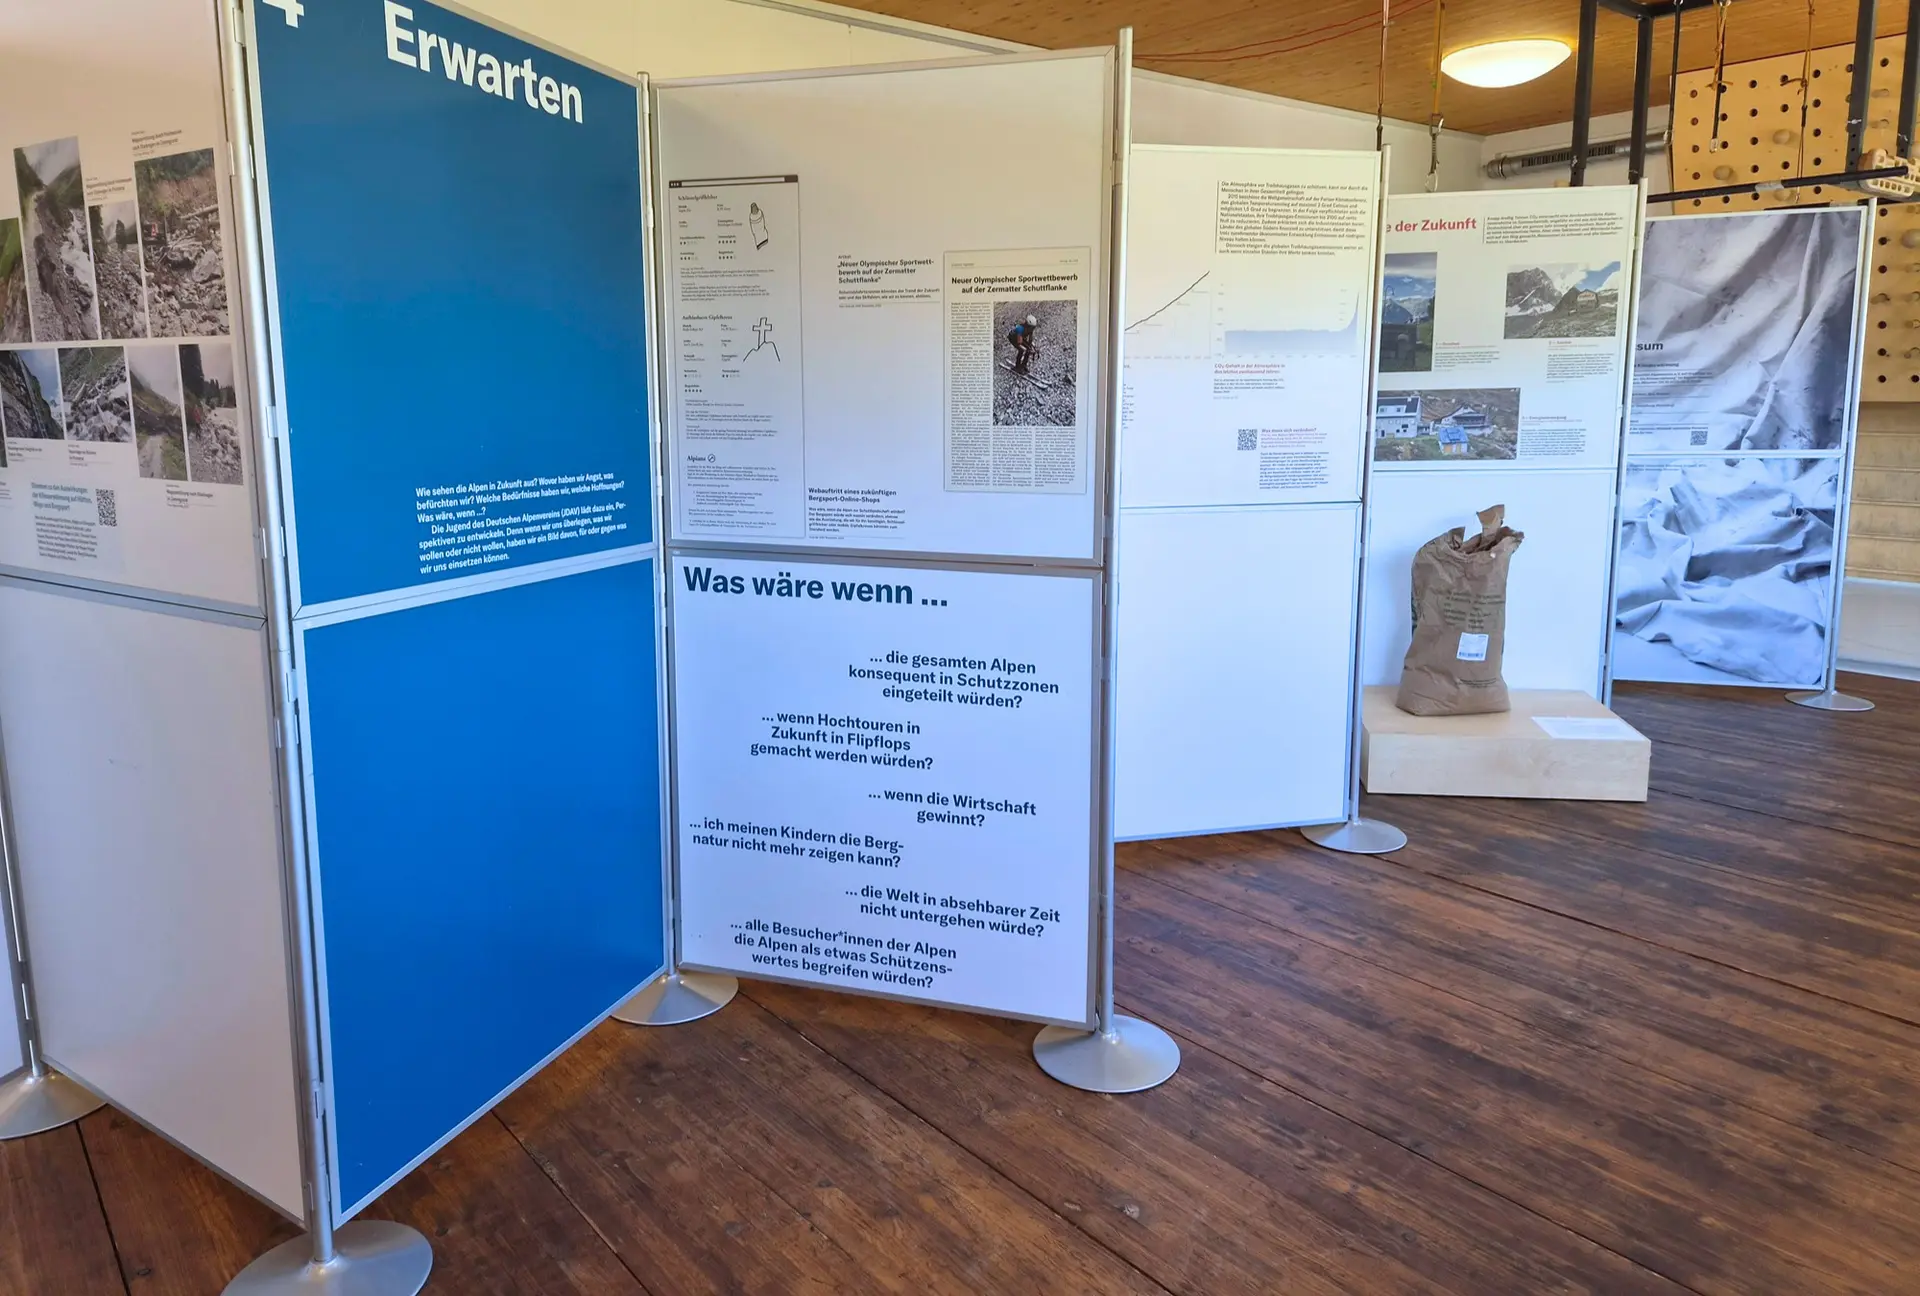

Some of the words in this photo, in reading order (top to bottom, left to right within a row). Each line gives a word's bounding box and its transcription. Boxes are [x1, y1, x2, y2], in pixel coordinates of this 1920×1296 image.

[384, 0, 583, 124] Erwarten
[1394, 220, 1418, 232] der
[1420, 217, 1476, 231] Zukunft
[415, 487, 431, 497] Wie
[432, 485, 455, 496] sehen
[455, 484, 467, 494] die
[467, 482, 488, 494] Alpen
[489, 481, 496, 490] in
[496, 478, 523, 490] Zukunft
[523, 477, 538, 487] aus?
[538, 477, 557, 486] Wovor
[557, 475, 576, 484] haben
[576, 473, 585, 482] wir
[585, 472, 603, 482] Angst,
[416, 498, 458, 510] befürchten
[459, 495, 475, 506] wir?
[475, 493, 501, 504] Welche
[502, 489, 540, 501] Bedürfnisse
[540, 488, 560, 497] haben
[560, 486, 571, 495] wir,
[570, 484, 591, 494] welche
[591, 480, 625, 491] Hoffnungen?
[416, 513, 434, 523] Was
[434, 510, 456, 521] wäre,
[455, 509, 476, 518] wenn
[431, 524, 444, 534] Die
[445, 520, 471, 534] Jugend
[472, 519, 485, 529] des
[485, 515, 521, 527] Deutschen
[521, 510, 560, 523] Alpenvereins
[560, 507, 580, 518] (JDAV)
[580, 506, 592, 514] lädt
[418, 536, 456, 550] spektiven
[456, 535, 466, 544] zu
[466, 528, 505, 542] entwickeln.
[506, 527, 524, 536] Denn
[524, 524, 541, 533] wenn
[541, 522, 551, 531] wir
[551, 521, 563, 530] uns
[563, 517, 592, 528] überlegen,
[604, 513, 612, 521] wir
[419, 551, 444, 562] wollen
[445, 548, 462, 558] oder
[463, 544, 481, 555] nicht
[482, 542, 506, 552] wollen,
[506, 538, 526, 548] haben
[526, 536, 537, 544] wir
[537, 535, 547, 543] ein
[547, 532, 559, 541] Bild
[559, 530, 578, 539] davon,
[587, 527, 600, 535] oder
[600, 524, 616, 534] gegen
[420, 564, 432, 574] wir
[433, 563, 447, 572] uns
[448, 557, 482, 570] einsetzen
[483, 553, 510, 563] können.
[683, 566, 745, 594] Was
[751, 571, 824, 599] wäre
[830, 581, 912, 604] wenn
[886, 650, 908, 664] die
[912, 654, 986, 670] gesamten
[990, 658, 1036, 676] Alpen
[849, 664, 936, 684] konsequent
[939, 671, 953, 685] in
[956, 672, 1059, 694] Schutzzonen
[882, 687, 953, 703] eingeteilt
[956, 691, 1022, 708] würden?
[776, 712, 814, 725] wenn
[818, 713, 903, 733] Hochtouren
[907, 720, 920, 734] in
[771, 725, 828, 743] Zukunft
[831, 731, 844, 744] in
[847, 732, 911, 753] Flipflops
[750, 743, 812, 758] gemacht
[814, 749, 867, 764] werden
[870, 752, 933, 770] würden?
[884, 790, 923, 803] wenn
[926, 791, 949, 806] die
[952, 794, 1036, 816] Wirtschaft
[916, 810, 985, 827] gewinnt?
[704, 816, 724, 831] ich
[727, 821, 777, 837] meinen
[780, 825, 836, 844] Kindern
[839, 832, 861, 846] die
[864, 835, 904, 854] Berg-
[692, 834, 729, 847] natur
[732, 837, 767, 852] nicht
[770, 842, 806, 856] mehr
[808, 846, 854, 863] zeigen
[857, 850, 901, 868] kann?
[860, 885, 882, 899] die
[886, 887, 920, 904] Welt
[923, 892, 936, 906] in
[940, 895, 1026, 918] absehbarer
[1029, 906, 1060, 923] Zeit
[860, 904, 897, 918] nicht
[900, 909, 985, 929] untergehen
[988, 919, 1044, 937] würde?
[734, 932, 754, 946] die
[757, 936, 797, 952] Alpen
[800, 942, 821, 956] als
[824, 947, 866, 962] etwas
[869, 951, 953, 974] Schützens-
[745, 919, 769, 936] alle
[886, 937, 911, 952] der
[913, 941, 956, 959] Alpen
[751, 953, 799, 969] wertes
[802, 957, 868, 979] begreifen
[872, 970, 933, 988] würden?
